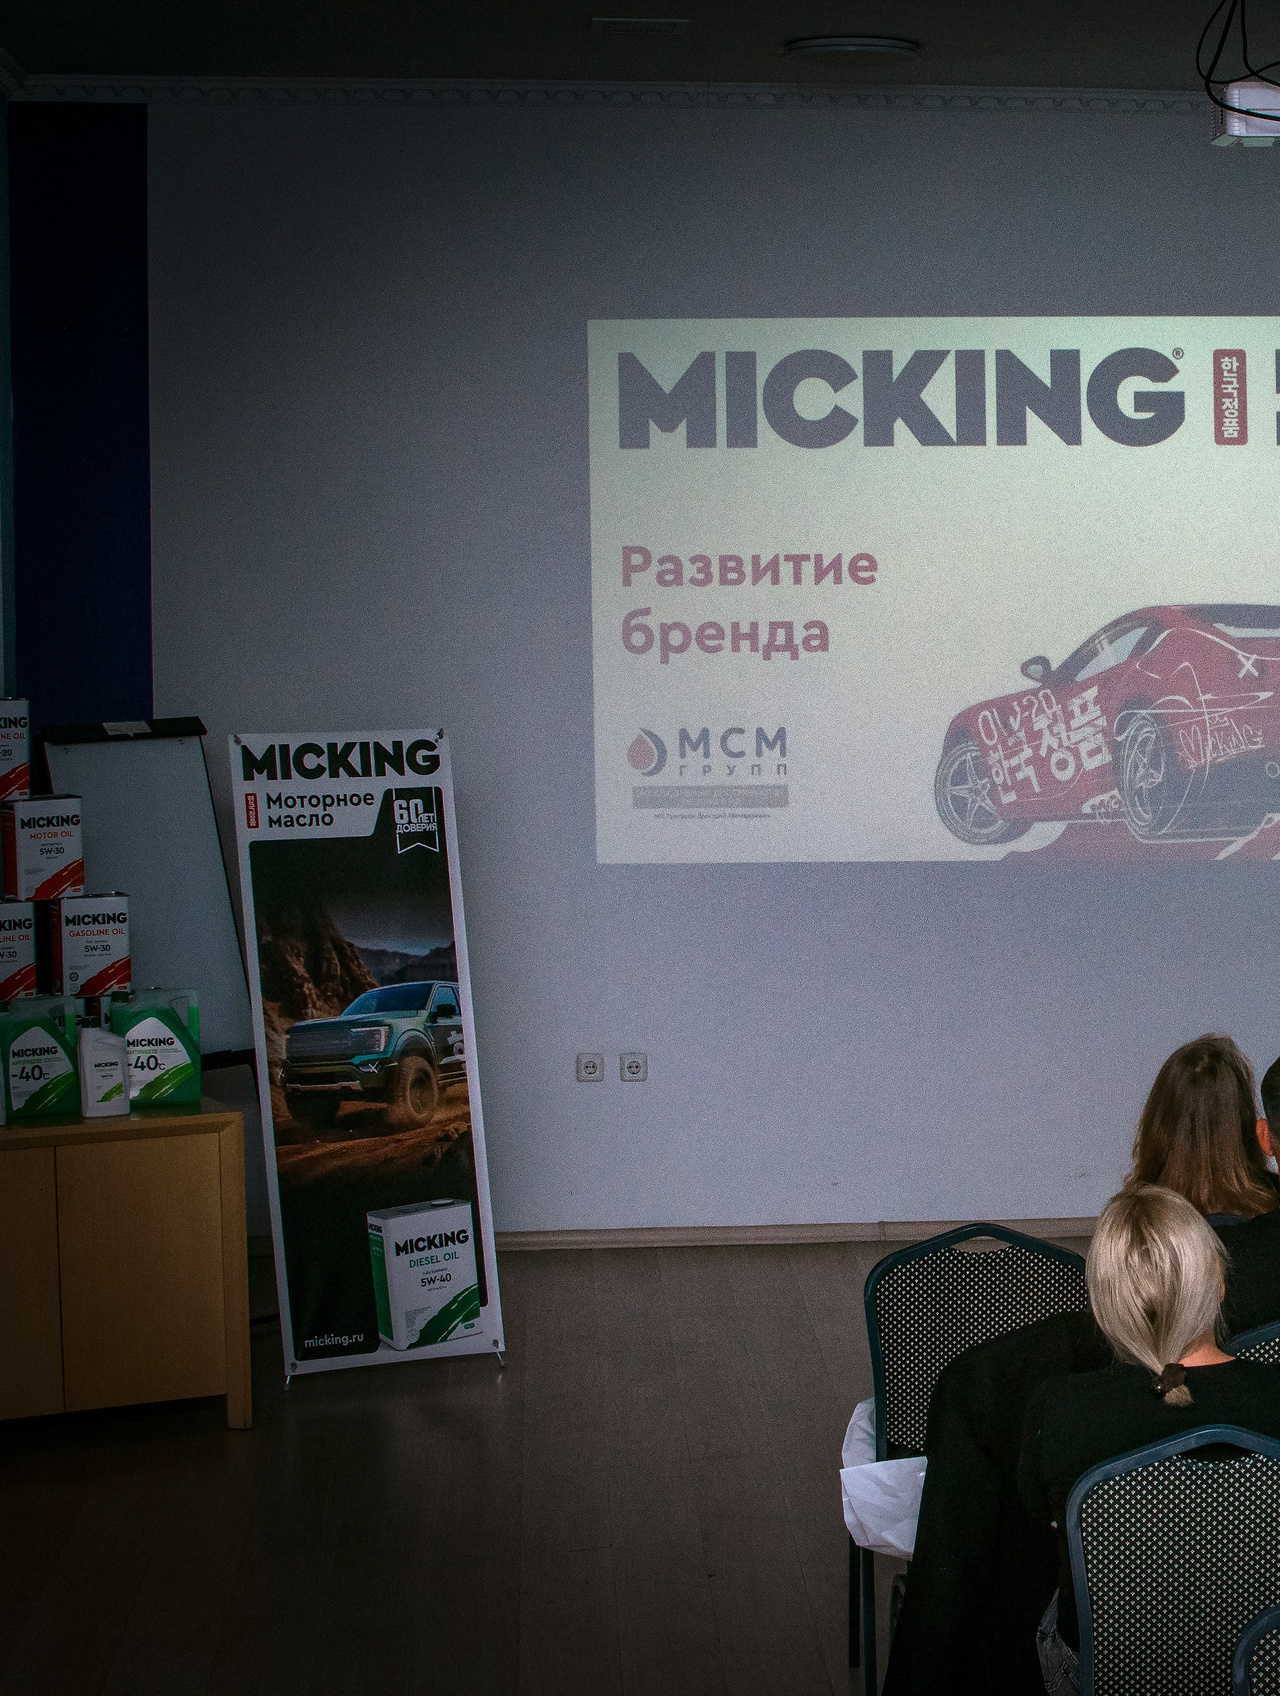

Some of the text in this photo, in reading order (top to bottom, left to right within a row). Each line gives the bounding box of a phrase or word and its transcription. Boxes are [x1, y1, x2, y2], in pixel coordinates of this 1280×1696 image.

[1220, 356, 1240, 439] 한국정품
[620, 545, 880, 588] Развитие
[620, 606, 831, 665] бренда
[678, 726, 788, 760] МСМ
[240, 738, 441, 782] MICKING
[265, 791, 376, 812] Моторное
[393, 798, 425, 825] 60
[20, 814, 81, 830] MICKING
[267, 812, 335, 829] масло
[395, 822, 438, 835] ДОВЕРИЯ
[29, 830, 74, 841] MOTOR OIL
[39, 846, 65, 856] 5W-30
[64, 912, 128, 927] MICKING
[18, 933, 32, 942] OIL
[68, 927, 126, 938] GASOLINE OIL
[84, 943, 111, 953] 5W-30
[126, 1036, 175, 1048] MICKING
[12, 1046, 58, 1059] MICKING
[94, 1060, 119, 1069] MICKING
[394, 1229, 470, 1257] MICKING
[408, 1250, 460, 1269] DIESEL OIL
[420, 1272, 452, 1288] 5W-40
[303, 1332, 364, 1349] micking.ru
